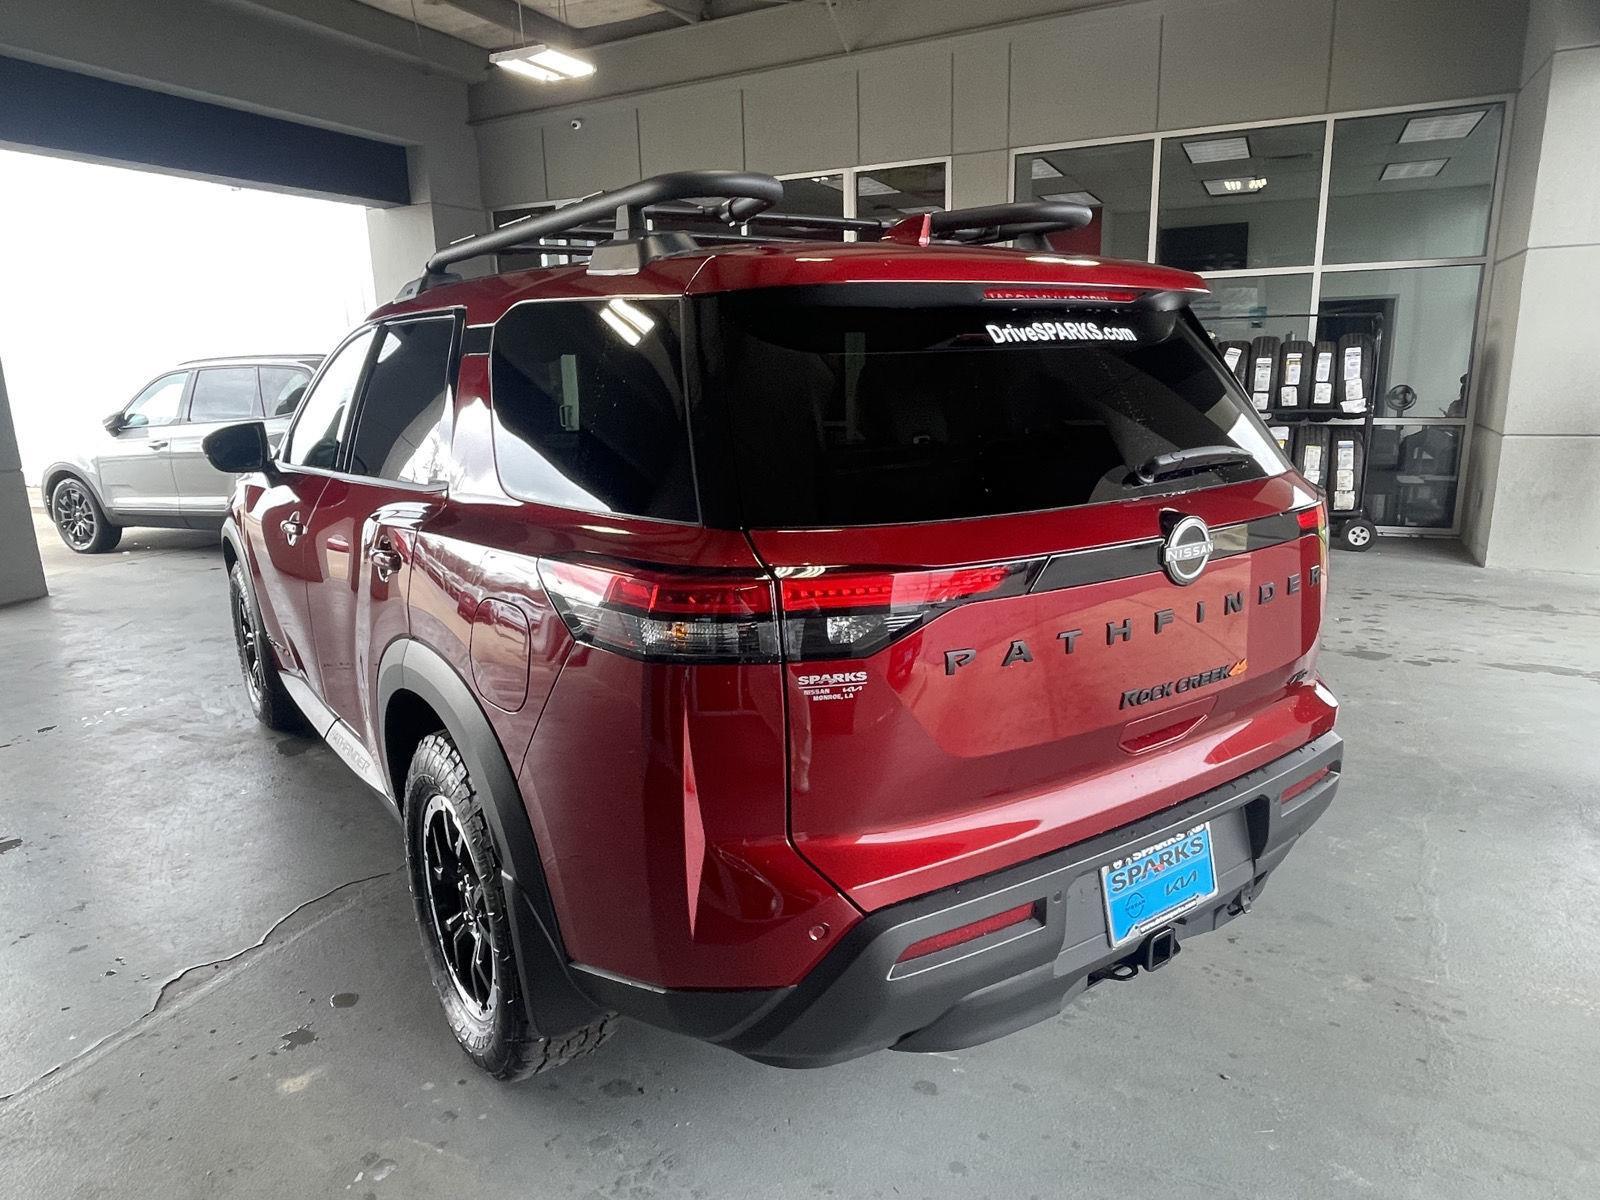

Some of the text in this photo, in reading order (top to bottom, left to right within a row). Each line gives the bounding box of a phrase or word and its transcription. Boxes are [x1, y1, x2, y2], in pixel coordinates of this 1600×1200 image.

[985, 321, 1138, 344] DriveSPARKS.com
[1167, 542, 1214, 560] NISSAN
[944, 564, 1321, 676] PATHFINDER
[798, 671, 868, 685] SPARKS
[1119, 664, 1232, 710] ROCK CREEK
[812, 693, 844, 701] MONROE,
[1111, 836, 1204, 892] SPARKS
